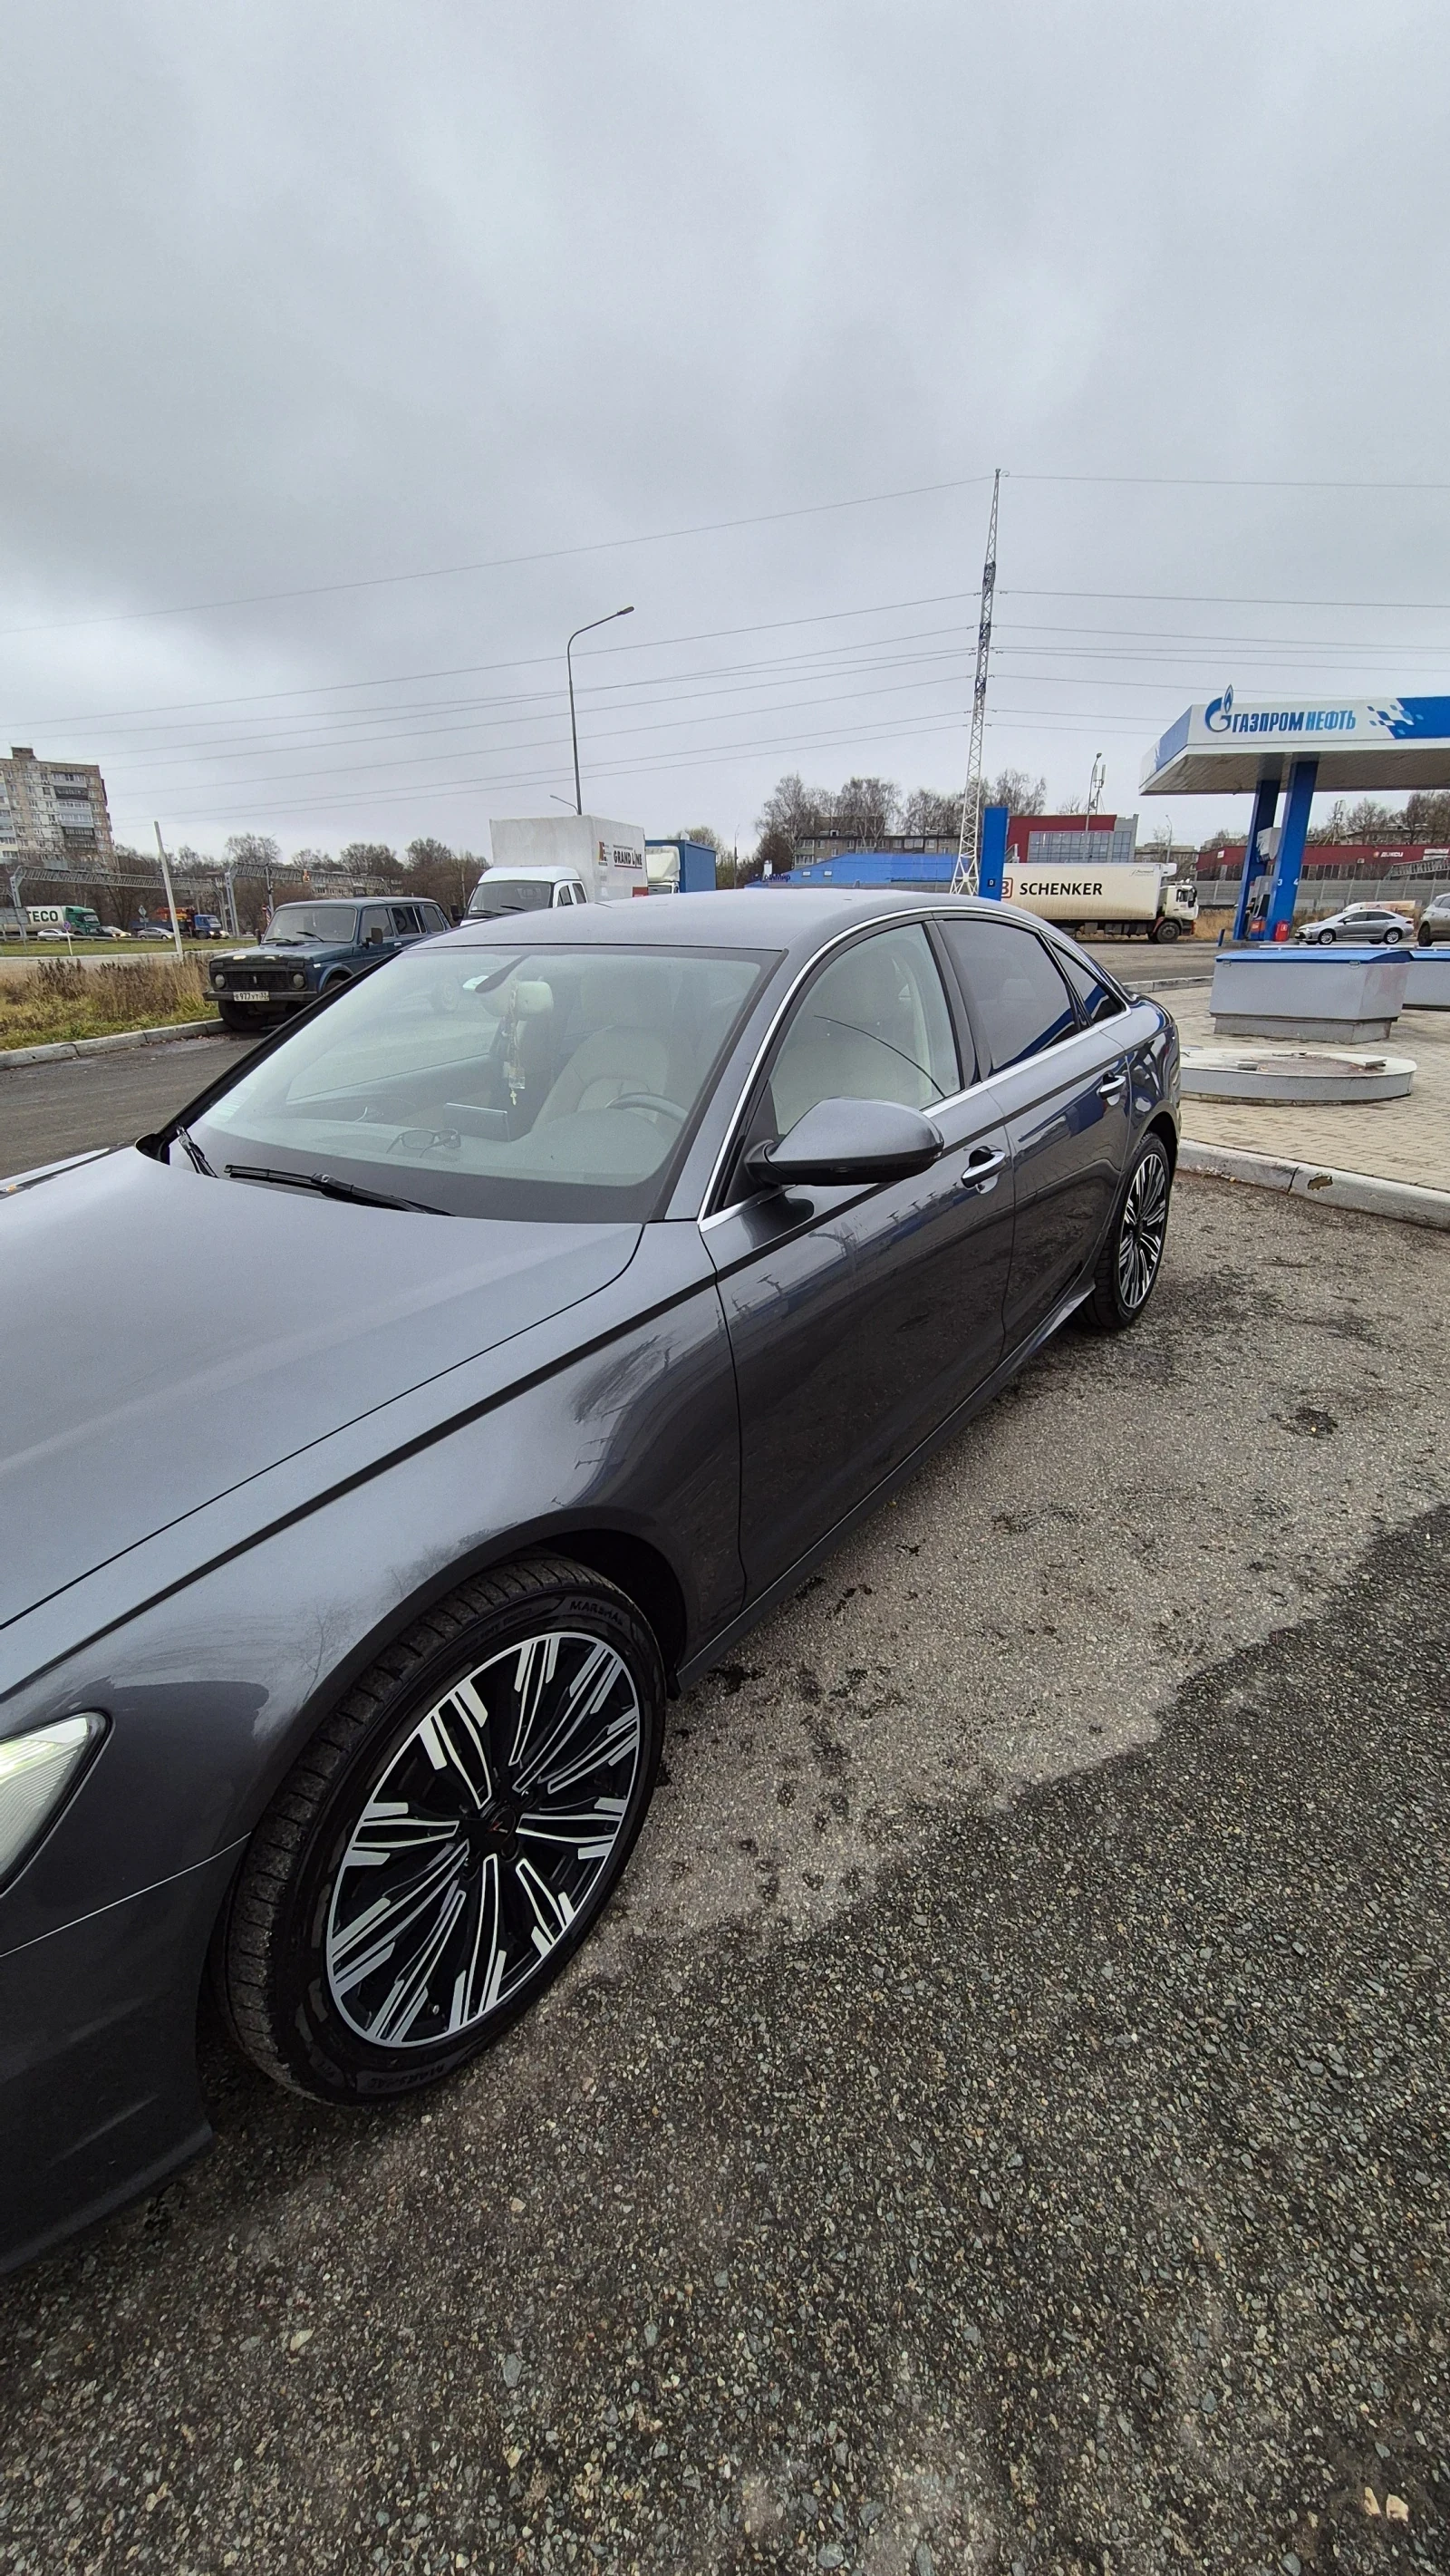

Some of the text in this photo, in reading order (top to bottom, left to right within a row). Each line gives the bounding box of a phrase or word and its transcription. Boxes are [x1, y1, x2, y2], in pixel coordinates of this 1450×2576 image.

[614, 850, 632, 865] GRAND
[632, 849, 643, 867] LINE
[1020, 883, 1103, 896] SCHENKER
